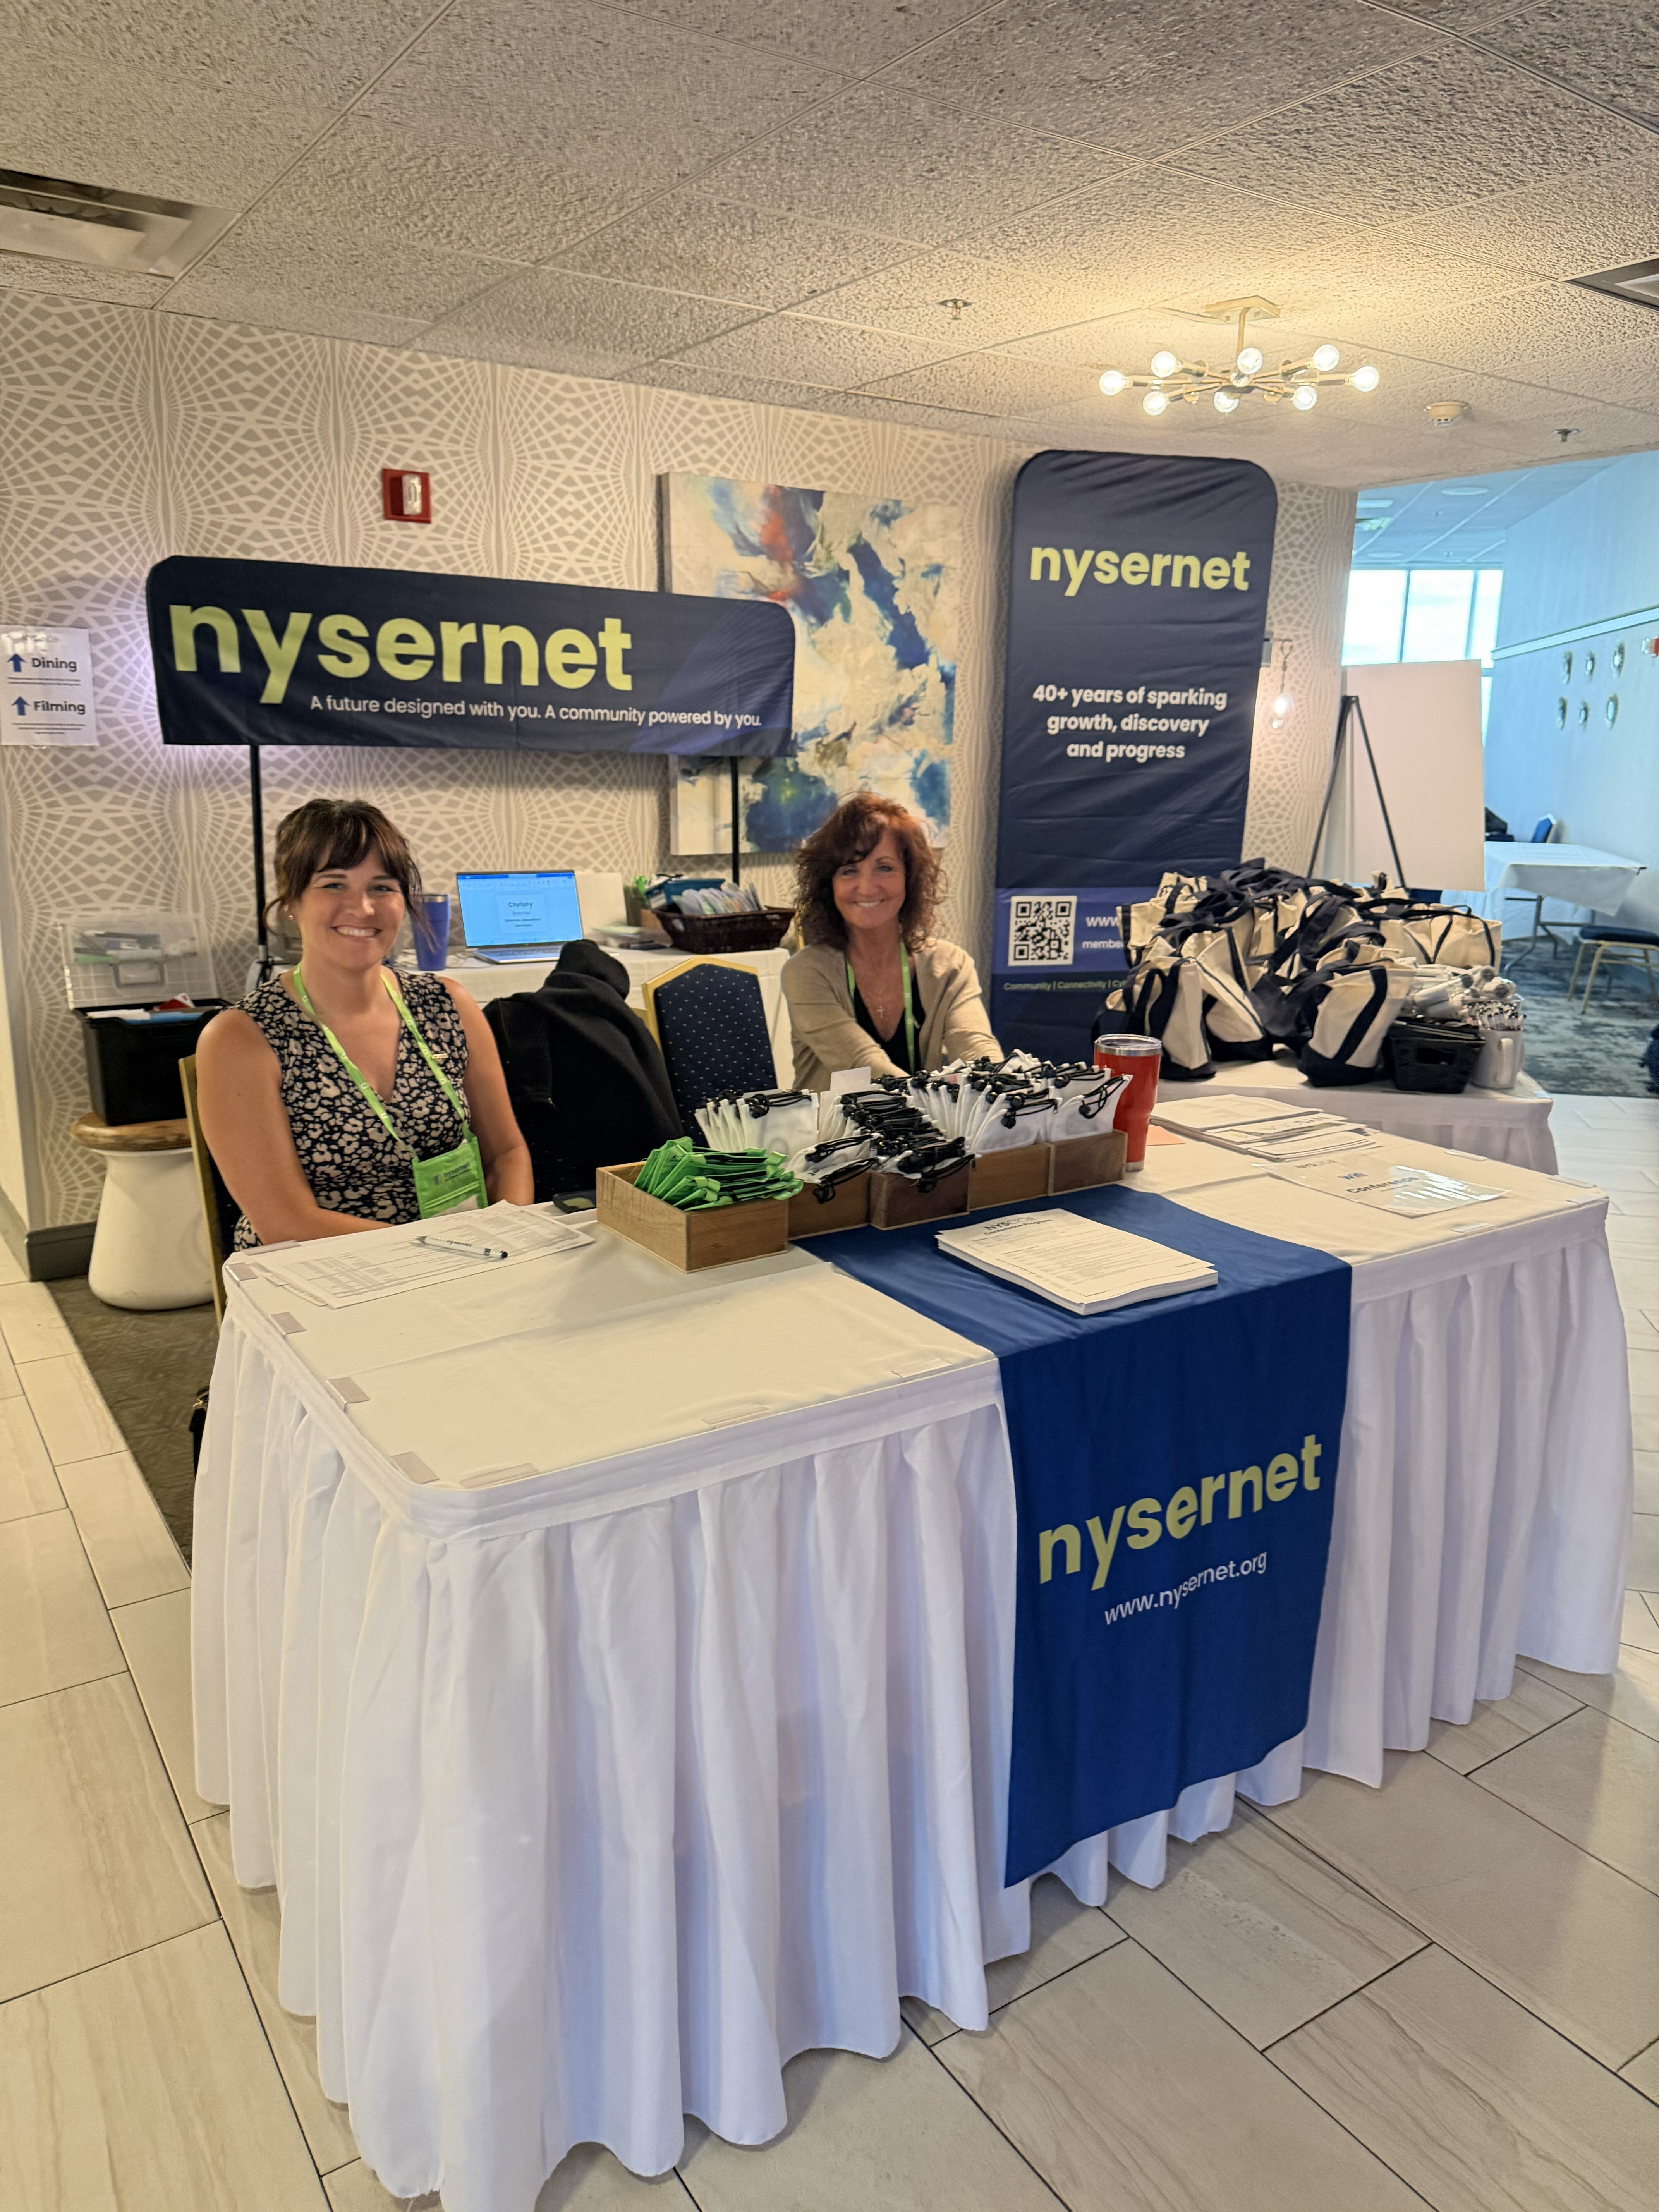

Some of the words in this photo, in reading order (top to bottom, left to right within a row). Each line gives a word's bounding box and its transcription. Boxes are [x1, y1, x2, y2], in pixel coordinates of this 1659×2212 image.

[1030, 547, 1250, 597] nysernet
[31, 657, 77, 672] Dining
[170, 605, 632, 704] nysernet
[33, 700, 86, 715] Filming
[1032, 684, 1069, 702] 40+
[1070, 689, 1123, 708] years
[1126, 686, 1146, 704] of
[1147, 687, 1228, 711] sparking
[310, 695, 323, 710] A
[325, 694, 380, 713] future
[383, 697, 466, 719] designed
[468, 701, 504, 717] with
[507, 705, 541, 722] you.
[544, 704, 556, 719] A
[558, 707, 646, 727] community
[648, 710, 712, 729] powered
[714, 710, 733, 730] by
[1046, 713, 1118, 735] growth,
[1120, 713, 1210, 737] discovery
[1066, 741, 1104, 758] and
[1106, 744, 1185, 763] progress
[1004, 982, 1051, 991] Community
[1058, 981, 1105, 989] Connectivity
[1346, 1177, 1419, 1193] Conference
[1039, 1434, 1322, 1591] nysernet
[1104, 1551, 1267, 1625] www.nysernet.org
